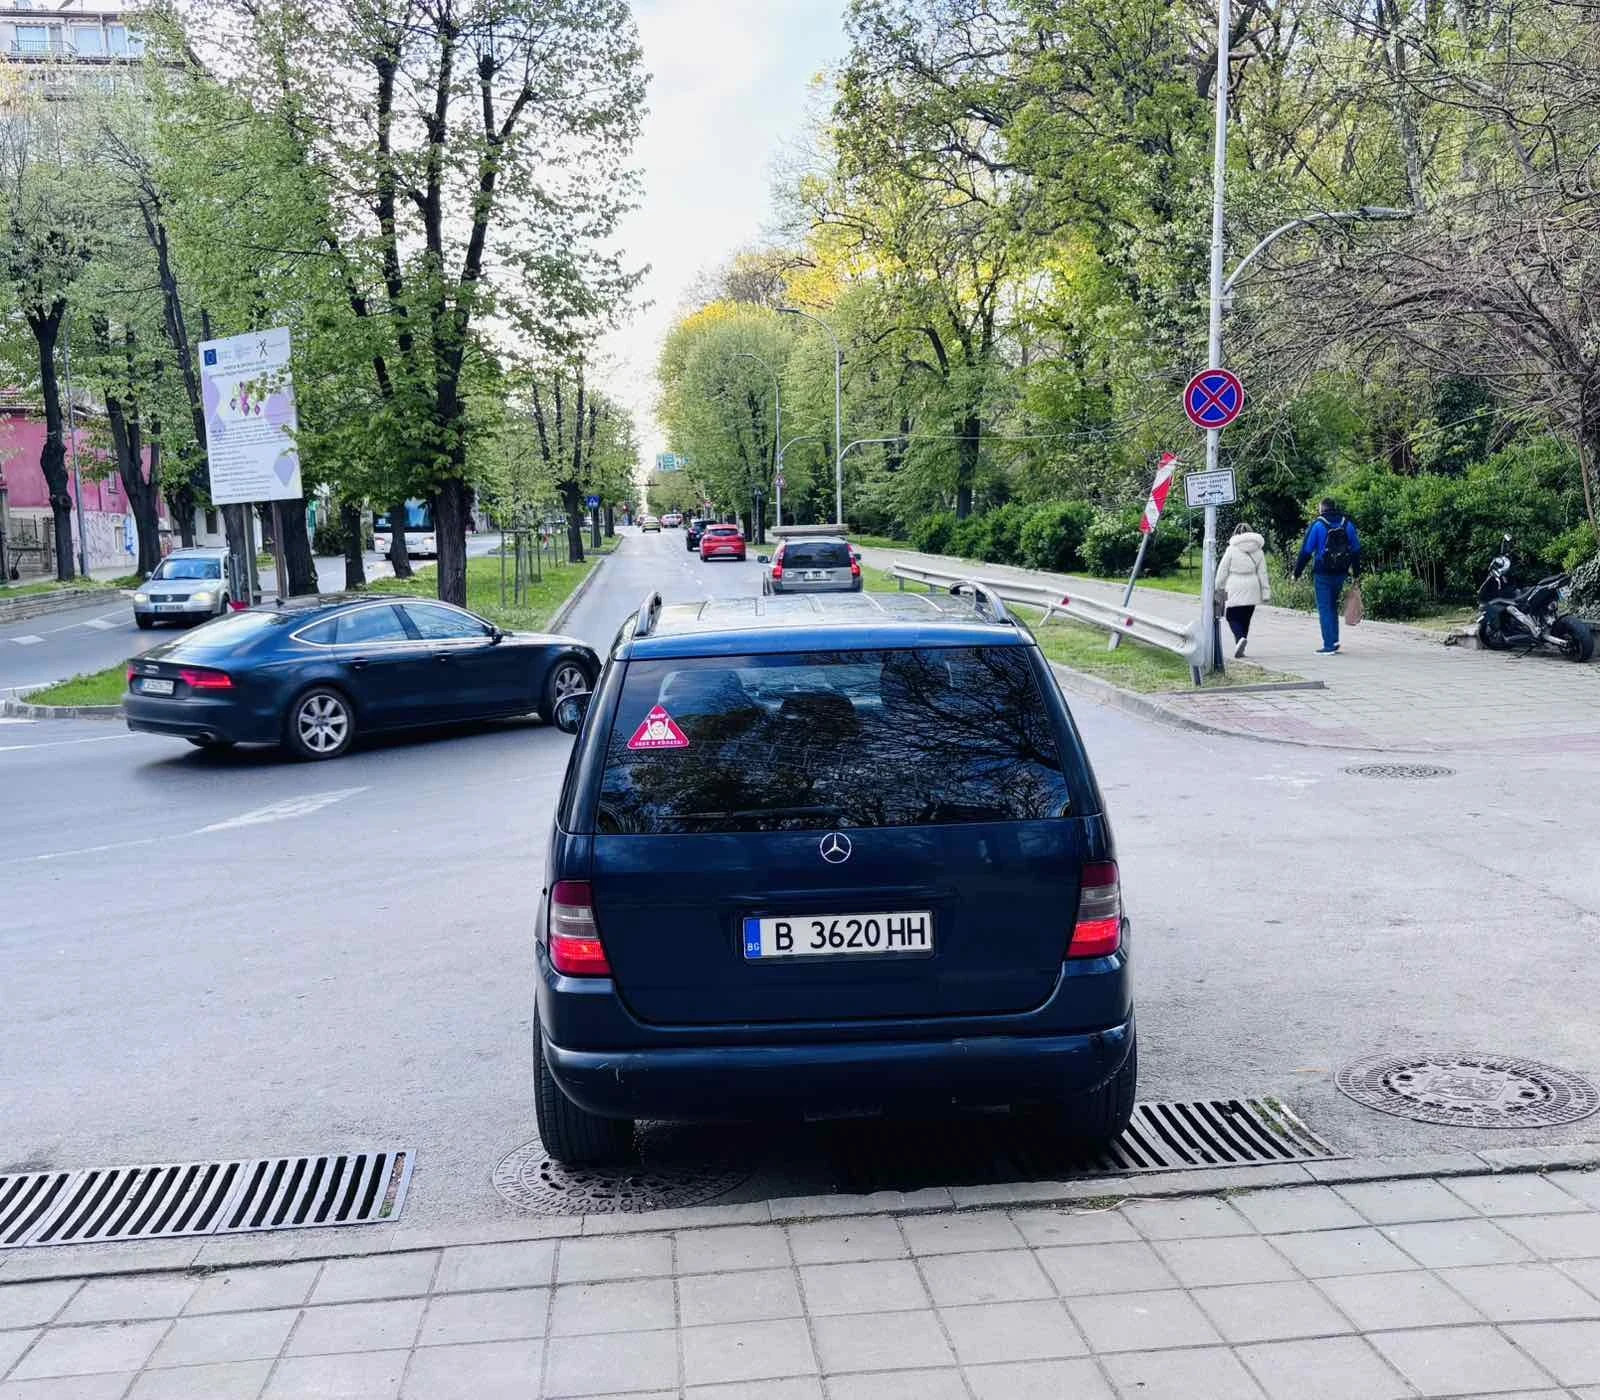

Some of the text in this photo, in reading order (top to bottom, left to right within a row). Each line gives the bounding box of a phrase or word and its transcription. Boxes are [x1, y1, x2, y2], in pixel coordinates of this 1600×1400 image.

[775, 917, 926, 951] B 3620 HH
[747, 943, 760, 952] BG
